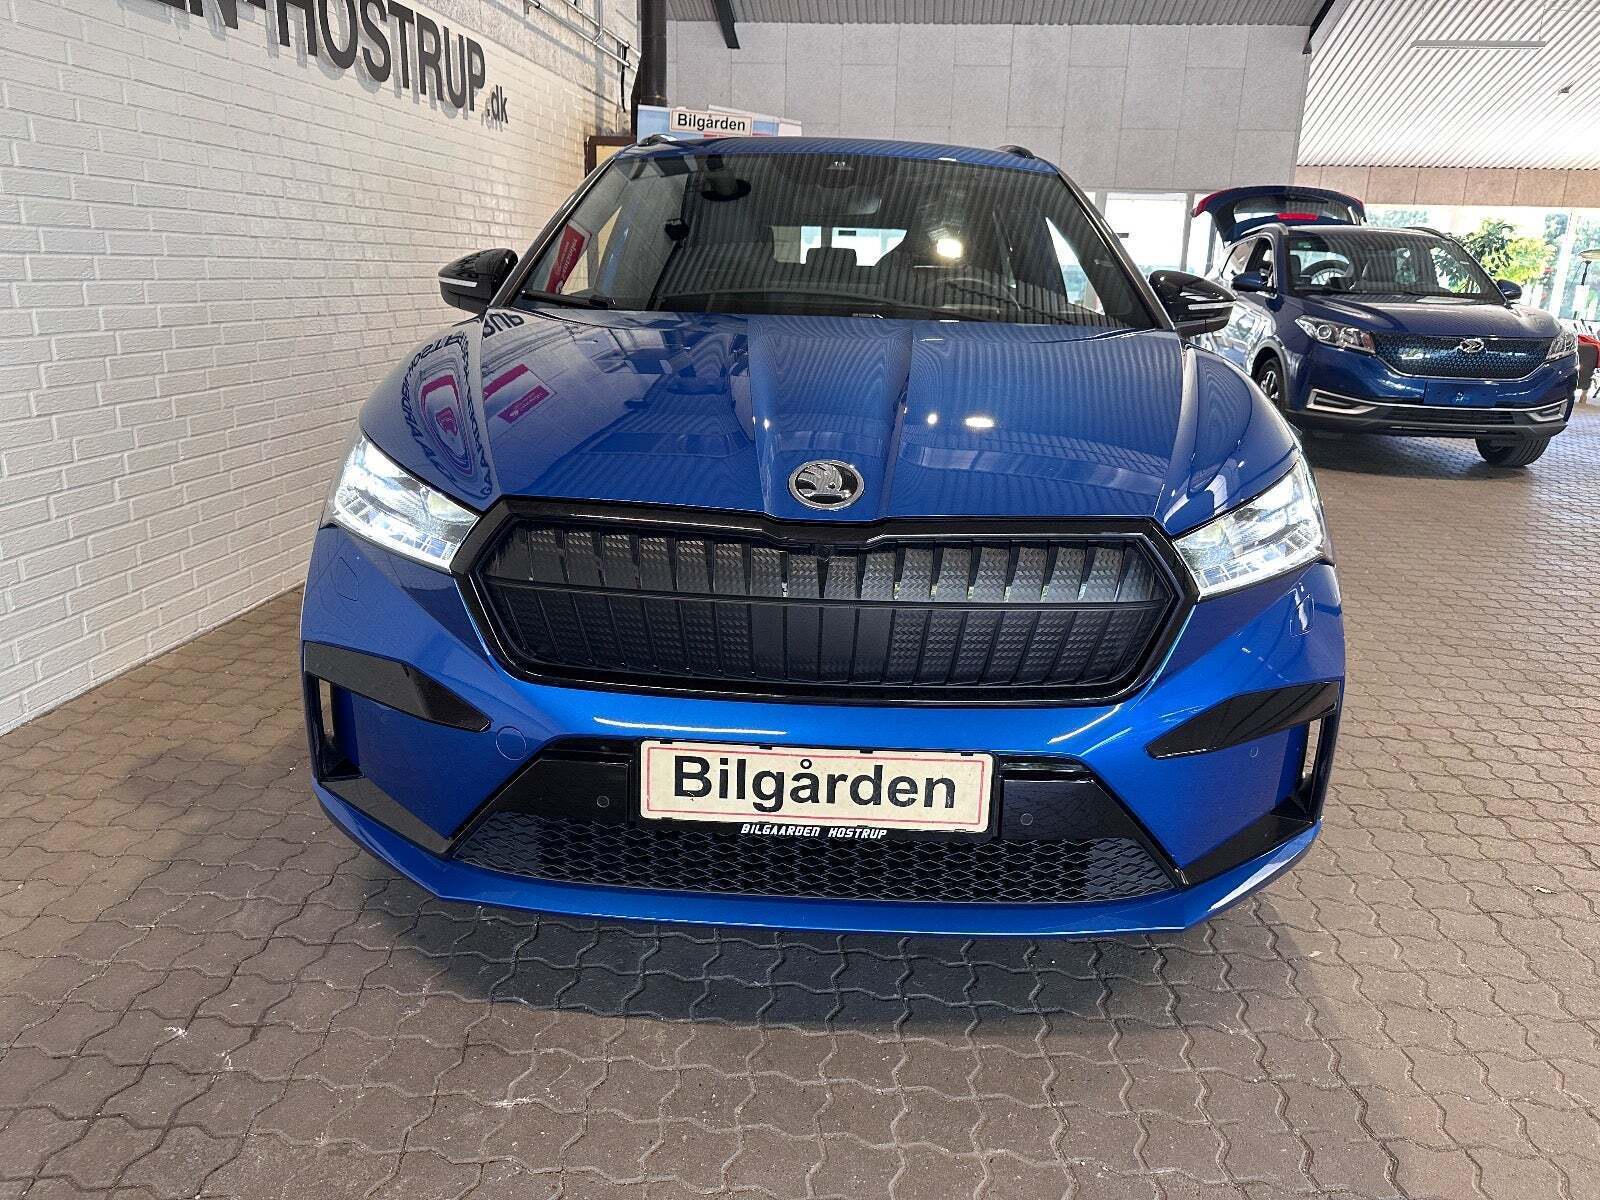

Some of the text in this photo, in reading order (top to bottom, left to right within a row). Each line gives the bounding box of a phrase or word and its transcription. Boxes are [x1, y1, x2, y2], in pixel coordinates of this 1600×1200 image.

[677, 113, 746, 131] Bilgården
[674, 755, 956, 812] Bilgården
[741, 823, 887, 839] BILGAARDEN HOSTRUP
